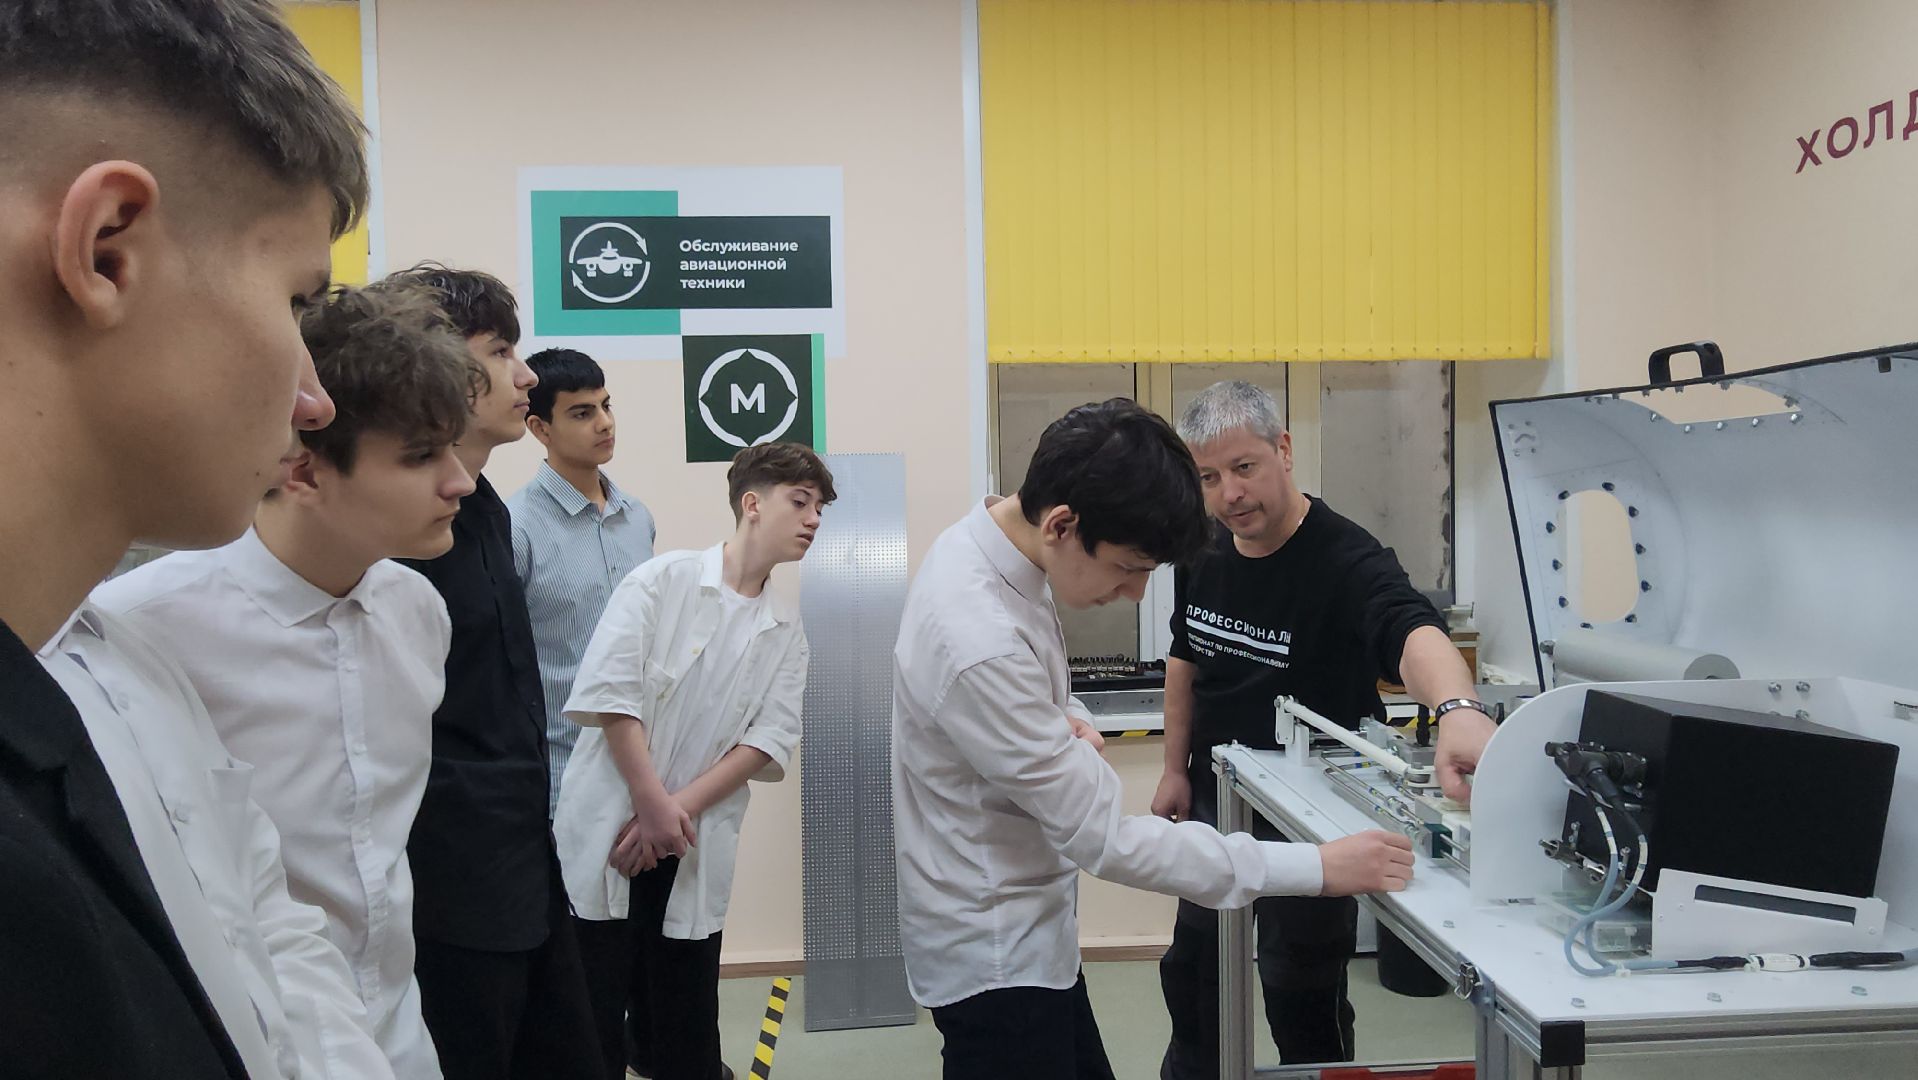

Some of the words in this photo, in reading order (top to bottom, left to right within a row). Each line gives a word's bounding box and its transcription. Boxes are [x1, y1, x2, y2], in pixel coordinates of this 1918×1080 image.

[679, 239, 799, 254] Обслуживание
[680, 258, 787, 271] авиационной
[680, 278, 746, 289] техники
[730, 383, 766, 414] М
